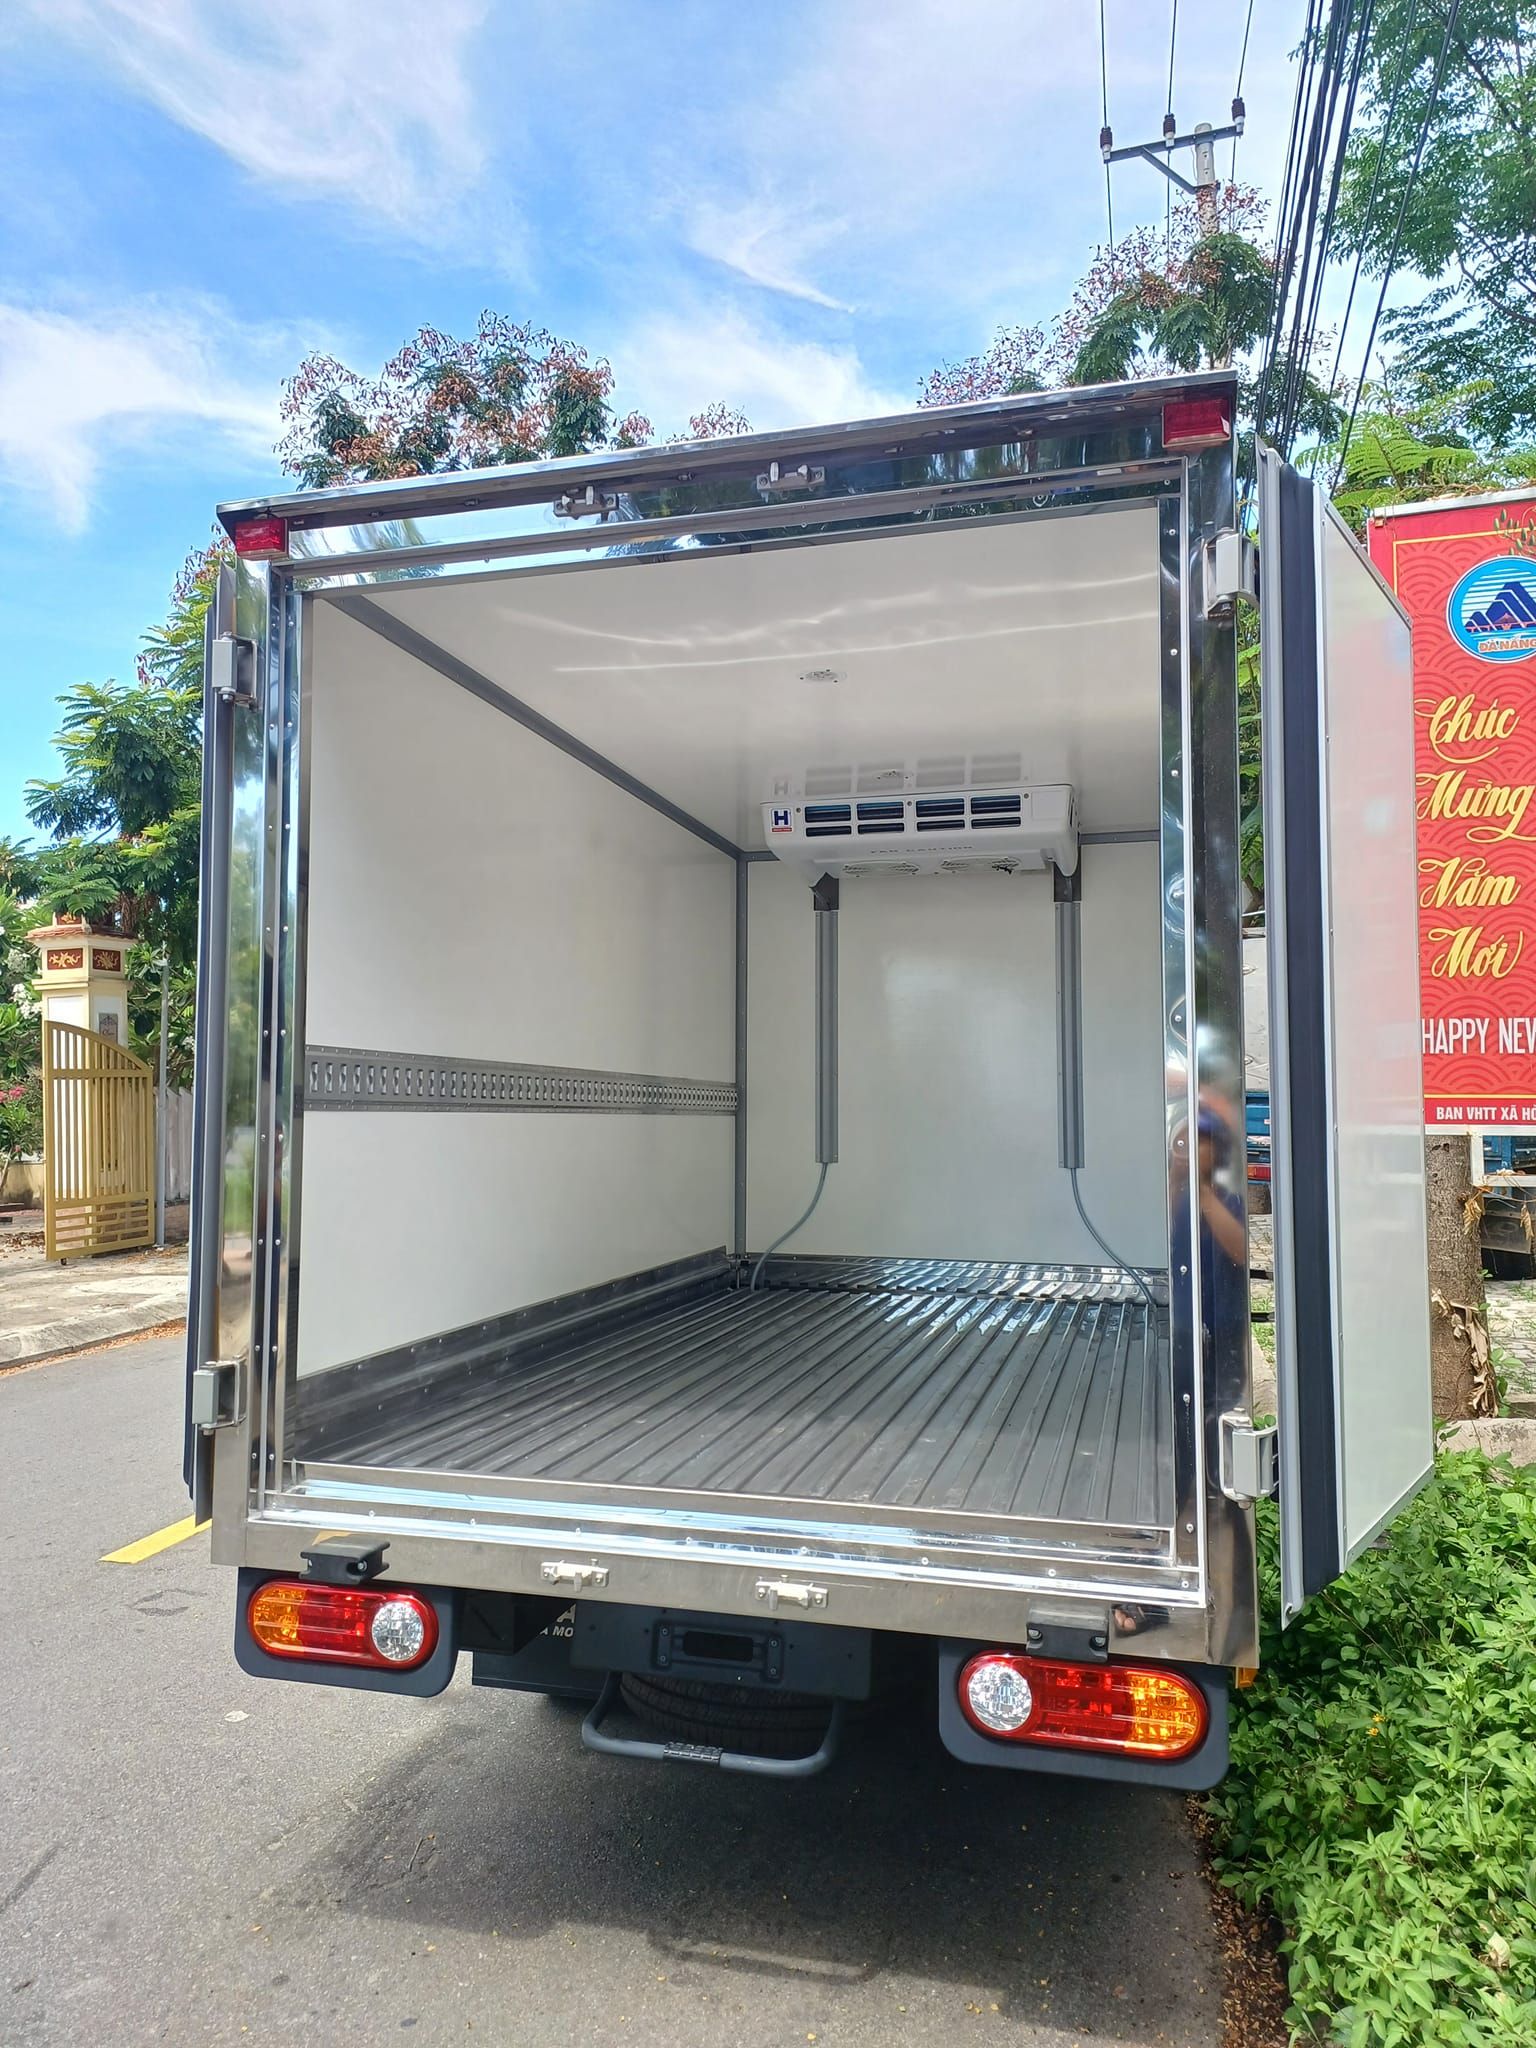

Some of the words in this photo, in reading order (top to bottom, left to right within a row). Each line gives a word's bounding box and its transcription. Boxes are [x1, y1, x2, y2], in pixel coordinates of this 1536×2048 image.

[1414, 693, 1520, 764] Chúc
[1416, 769, 1536, 843] Mừng
[1418, 857, 1521, 908] Năm
[1428, 926, 1523, 978] Mới
[1421, 1017, 1490, 1055] HAPPY
[1436, 1106, 1463, 1120] BAN
[1466, 1106, 1497, 1120] VHTT
[1500, 1104, 1518, 1121] XÃ
